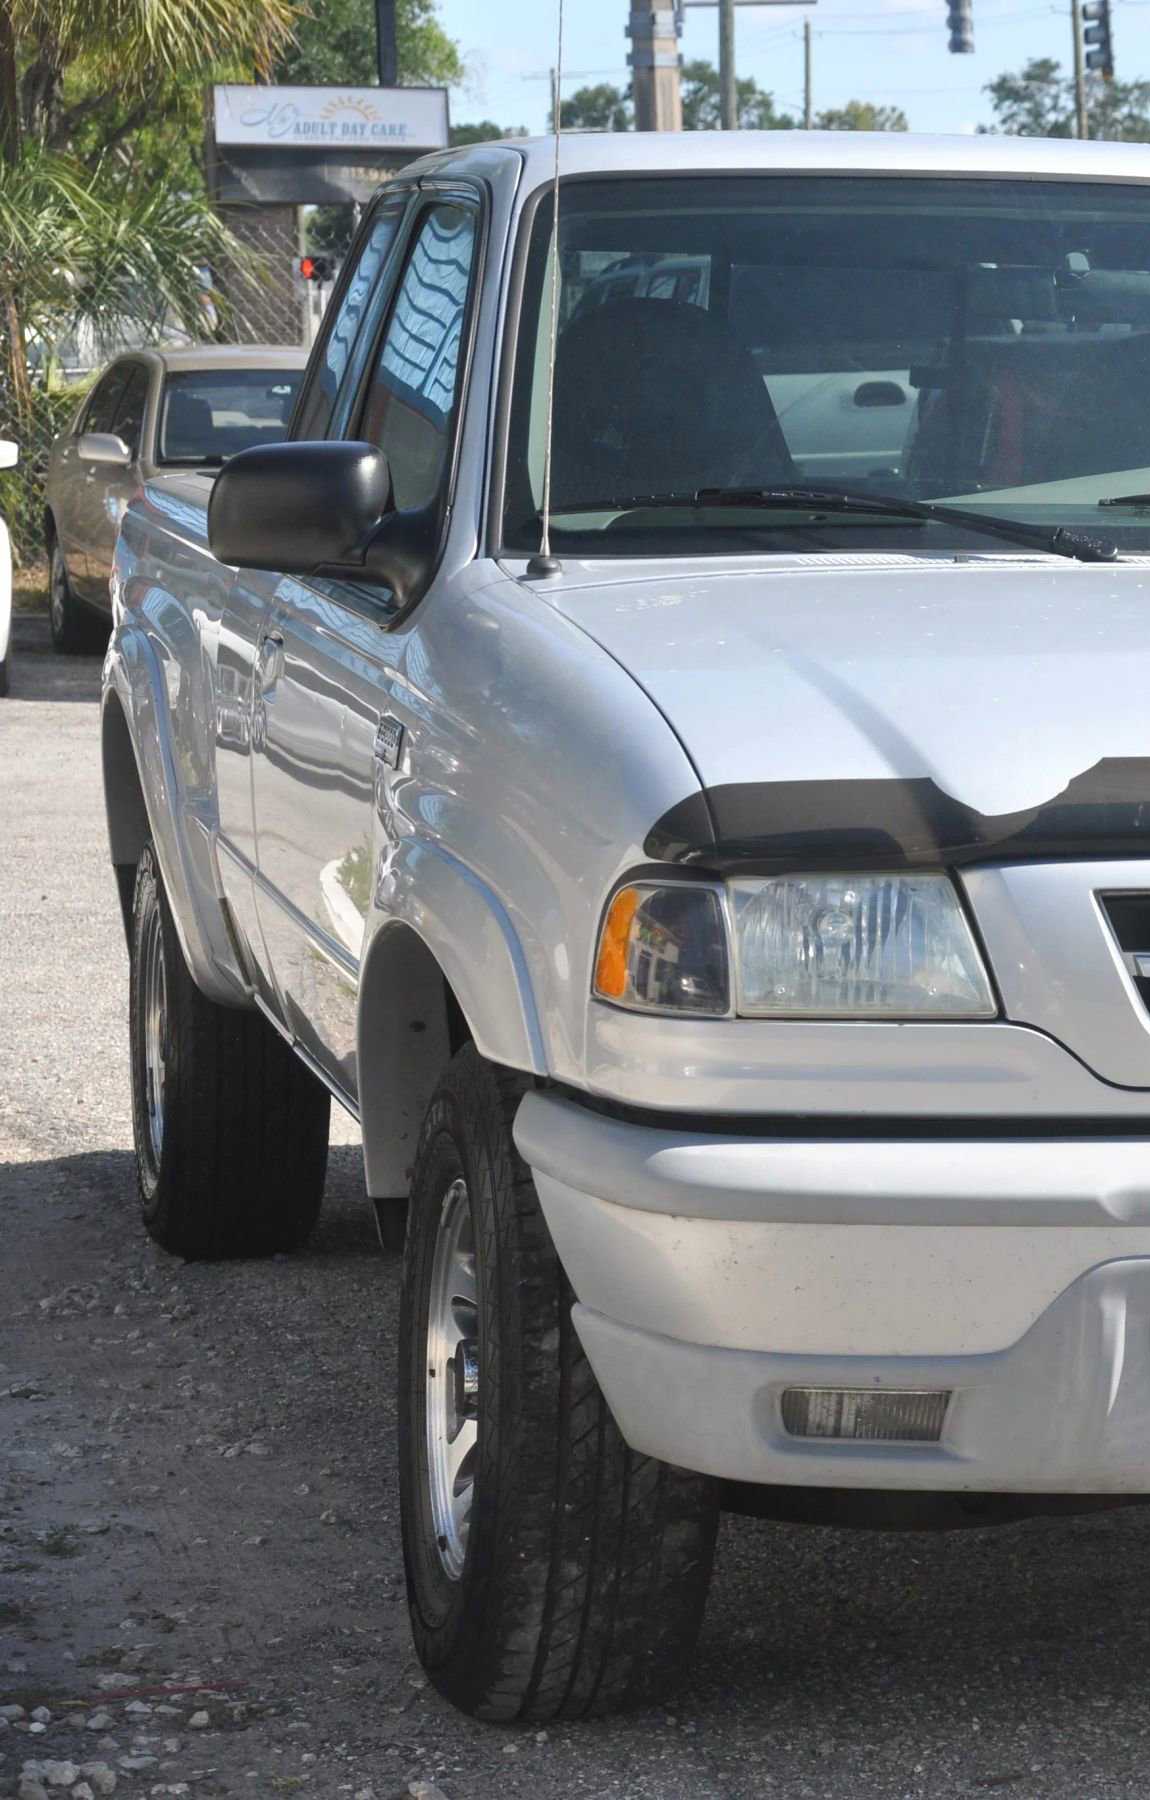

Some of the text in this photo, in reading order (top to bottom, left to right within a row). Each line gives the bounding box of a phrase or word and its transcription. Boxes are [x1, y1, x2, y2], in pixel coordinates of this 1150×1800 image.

[294, 122, 407, 137] ADULT DAY CARE
